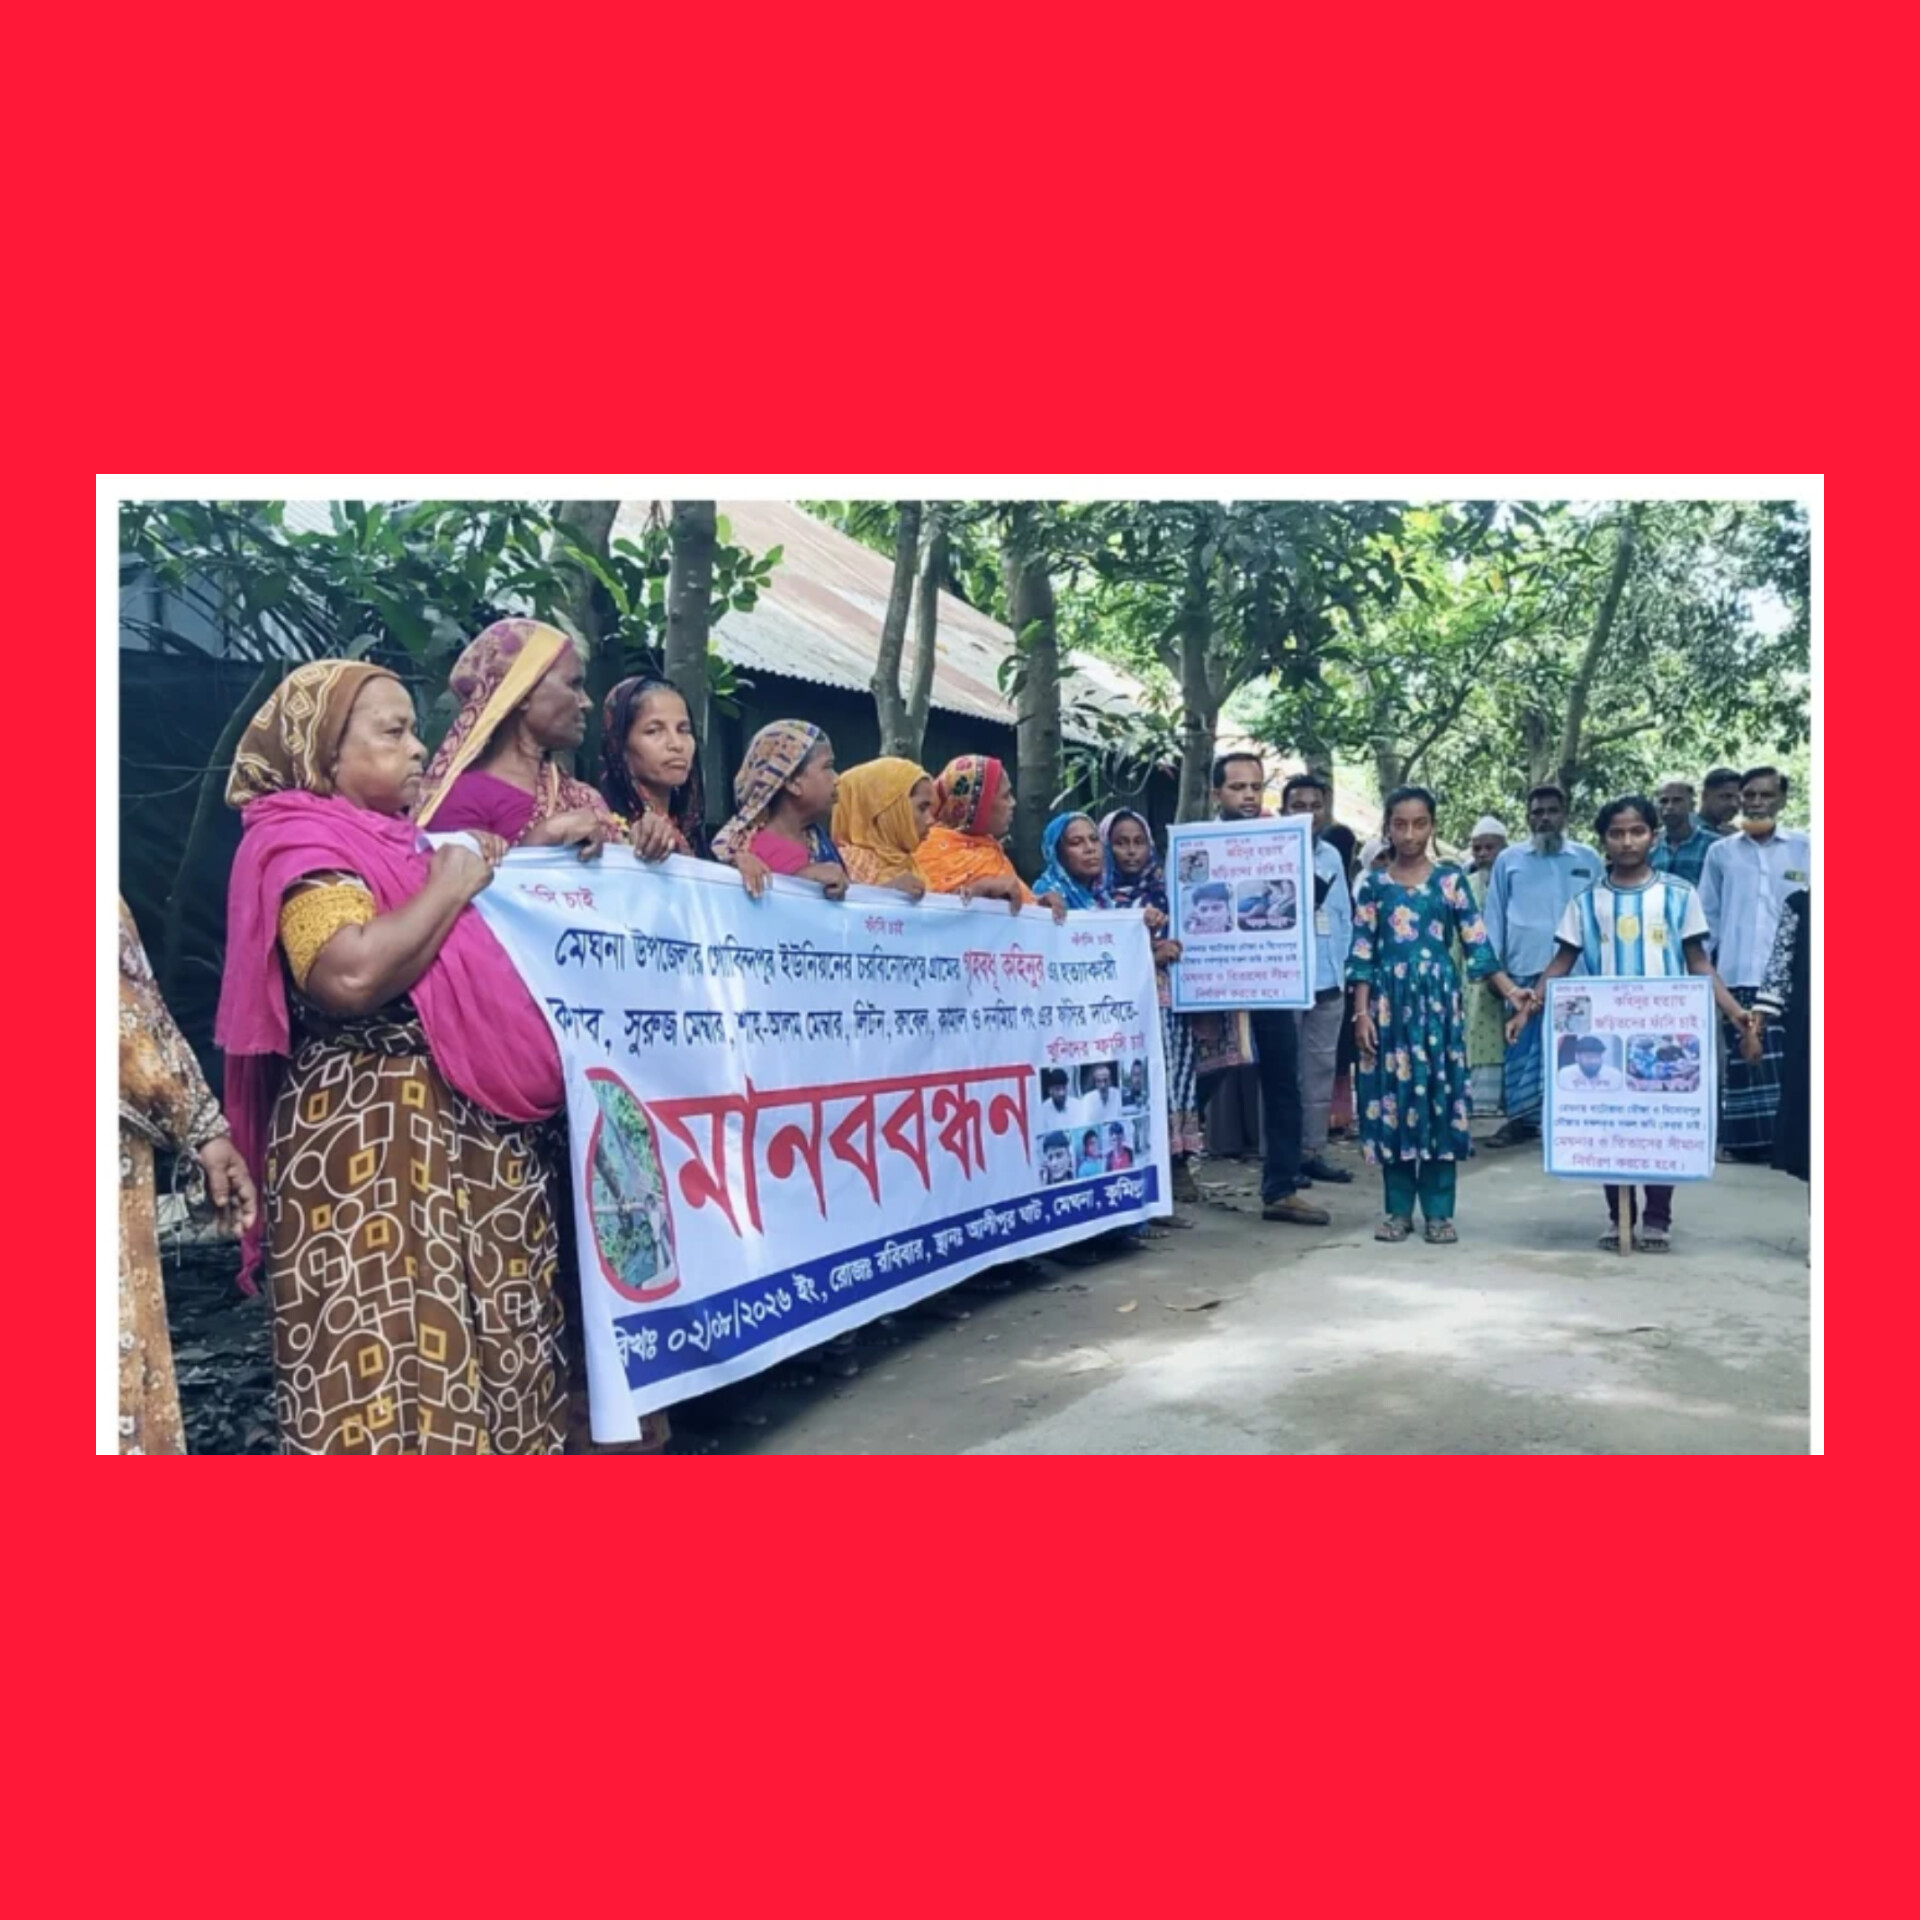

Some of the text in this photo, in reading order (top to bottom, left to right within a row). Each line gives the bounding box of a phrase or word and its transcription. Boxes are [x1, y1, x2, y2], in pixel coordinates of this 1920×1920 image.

[555, 928, 626, 971] মেঘনা
[626, 925, 704, 976] উপজেলার
[778, 939, 853, 984] ইউনিয়নের
[624, 1010, 678, 1057] সুরুজ
[644, 1063, 1036, 1238] মানববন্ধন
